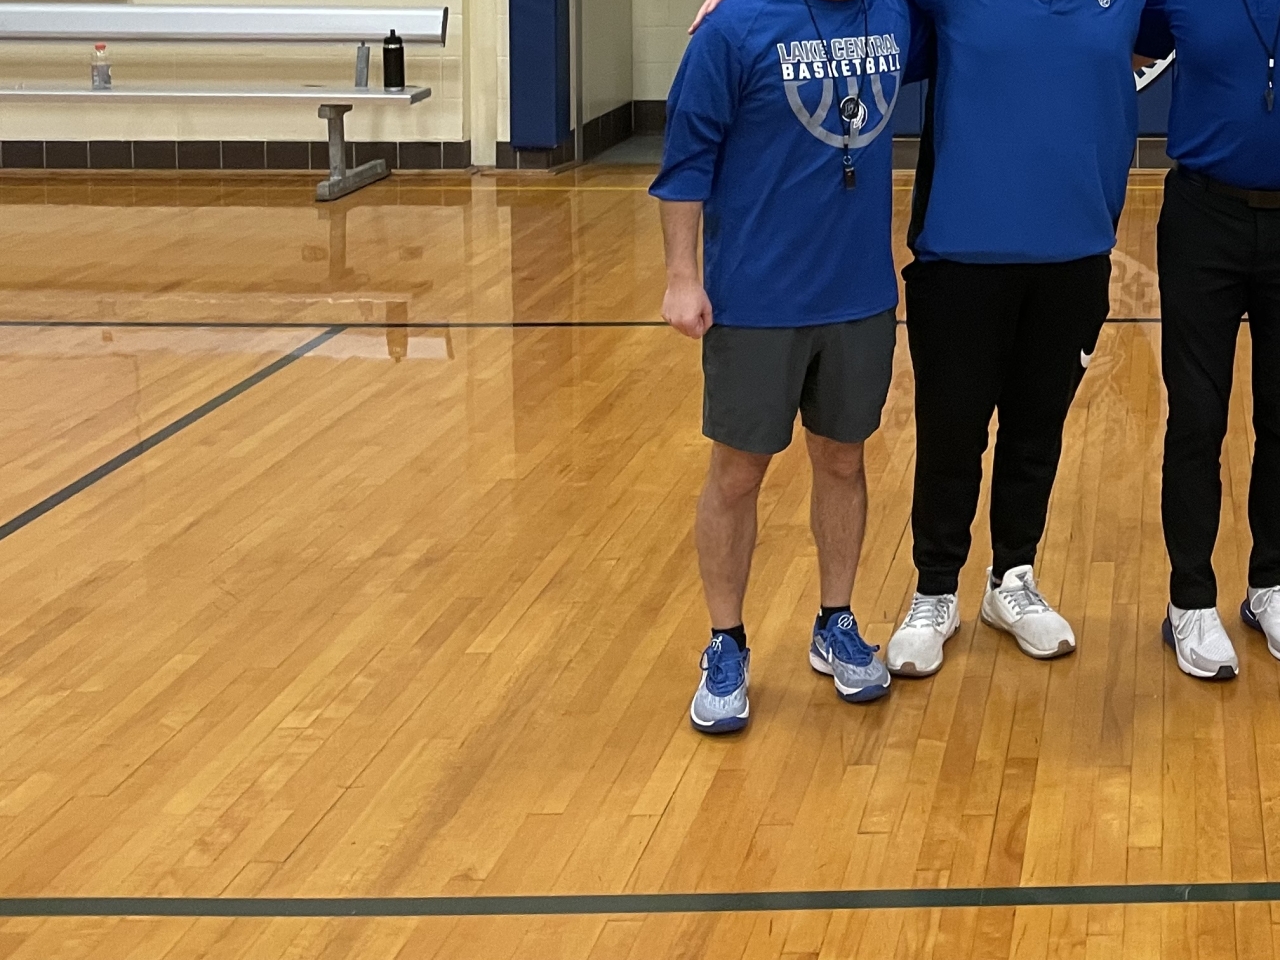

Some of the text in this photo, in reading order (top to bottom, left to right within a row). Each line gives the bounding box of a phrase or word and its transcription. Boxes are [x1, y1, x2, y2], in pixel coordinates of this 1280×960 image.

[777, 33, 900, 63] LAKE CENTRAL
[781, 54, 901, 80] BASKETBALL
